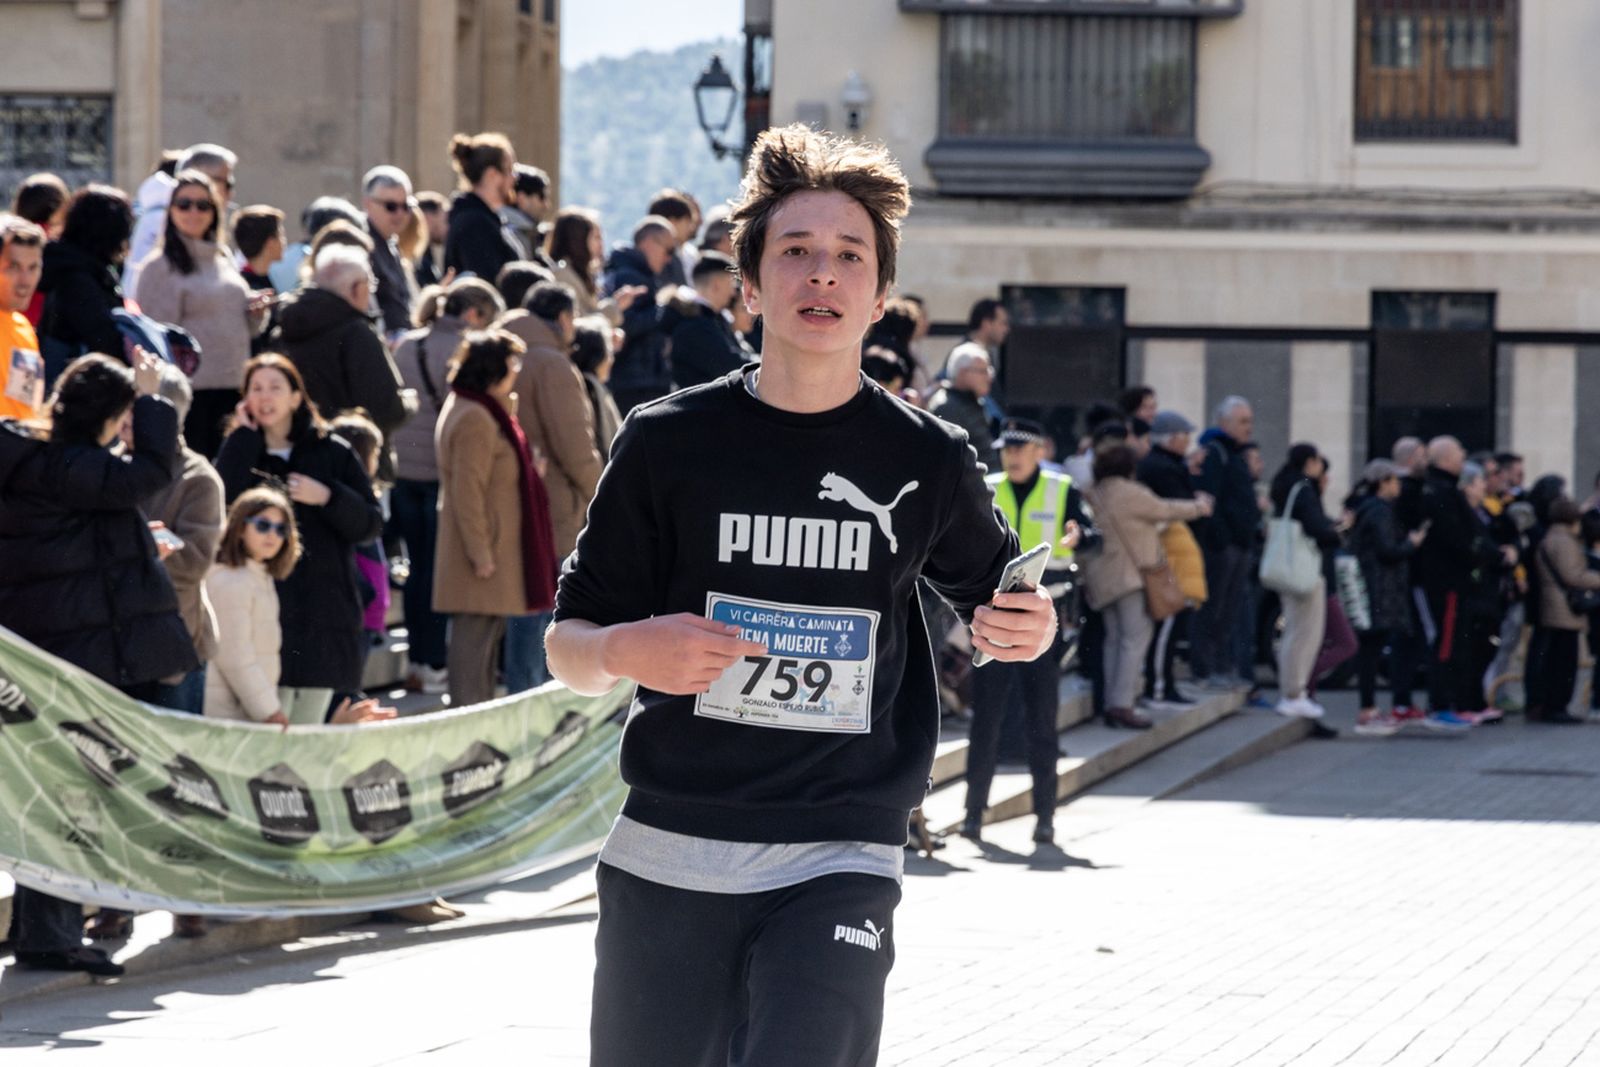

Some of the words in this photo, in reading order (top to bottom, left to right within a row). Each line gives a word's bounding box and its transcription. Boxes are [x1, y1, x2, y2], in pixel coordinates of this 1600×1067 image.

[718, 512, 872, 572] PUMA
[730, 609, 741, 621] VI
[743, 611, 795, 628] CARRERA
[799, 618, 854, 632] CAMINATA
[774, 633, 829, 654] MUERTE
[740, 656, 832, 703] 759
[742, 697, 777, 709] GONZALO
[779, 702, 803, 712] ESPEJO
[833, 924, 877, 951] PUMA
